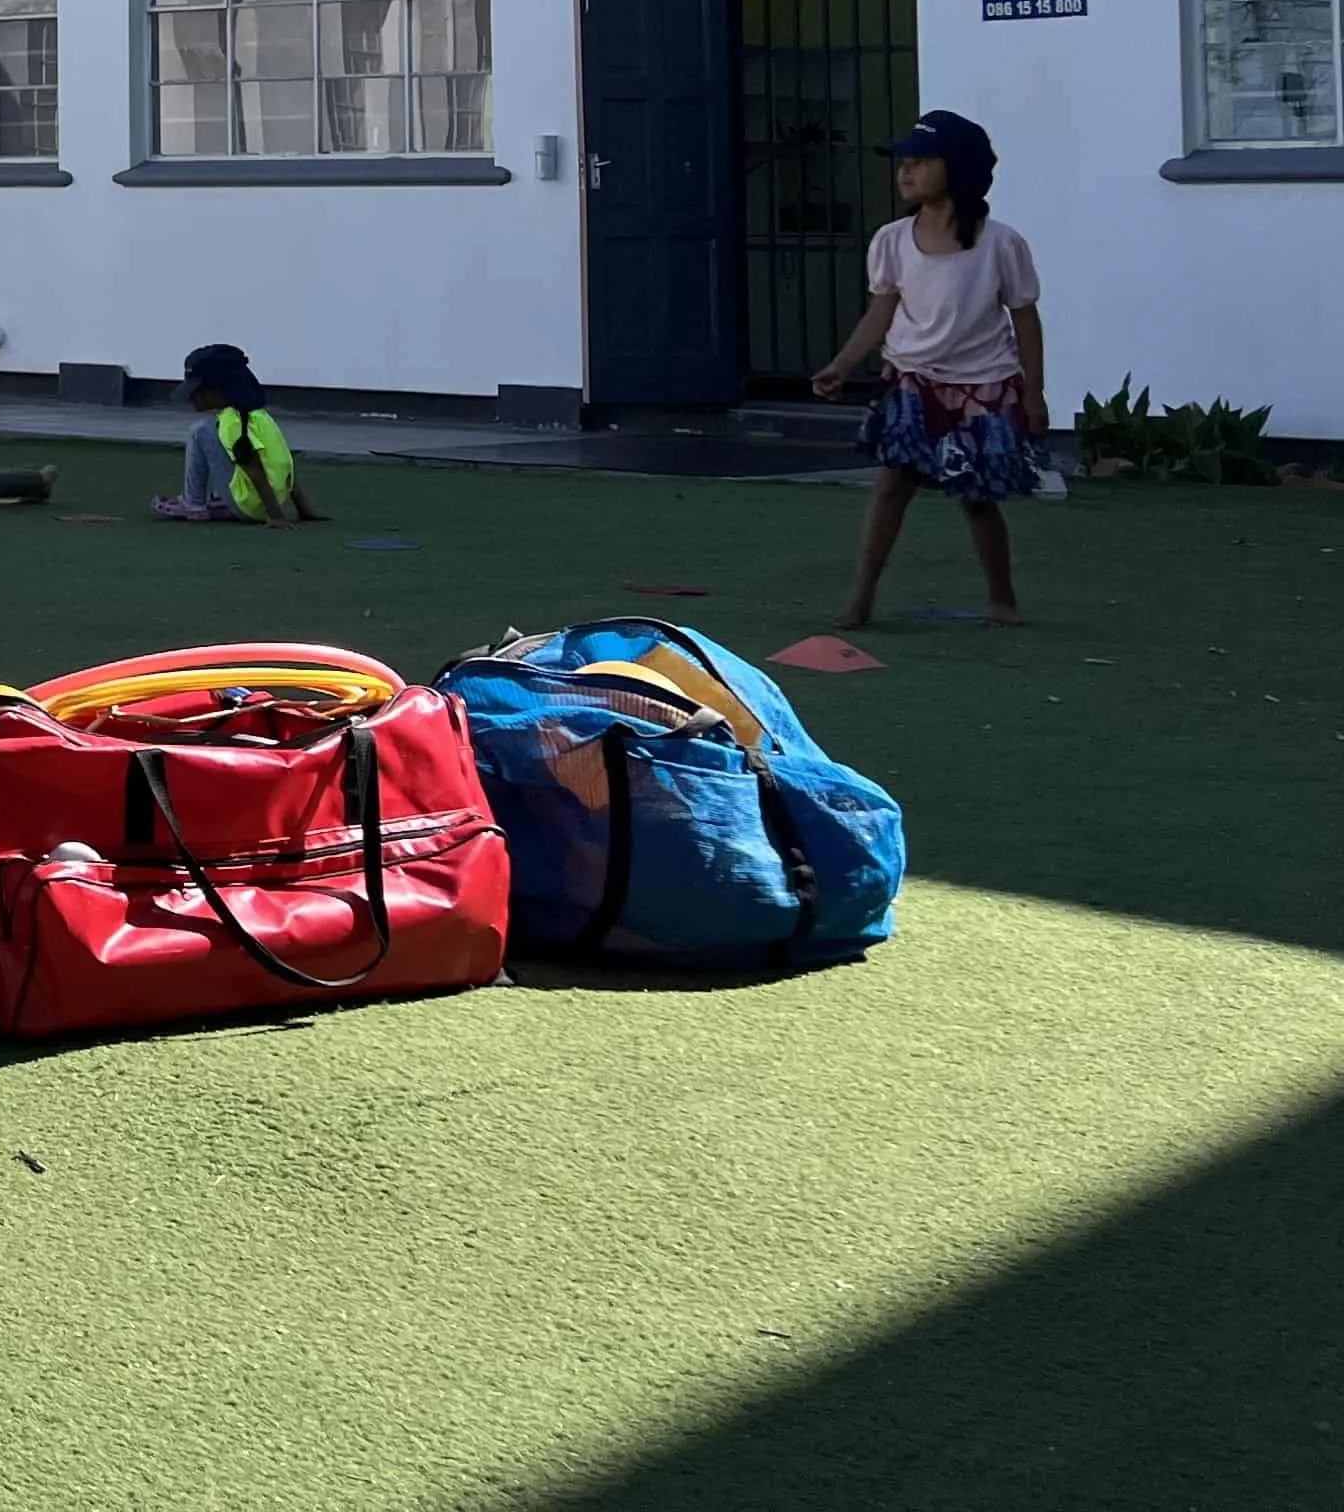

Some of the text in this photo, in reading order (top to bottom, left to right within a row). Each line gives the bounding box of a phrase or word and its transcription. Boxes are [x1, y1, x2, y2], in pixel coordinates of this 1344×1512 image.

[986, 2, 1012, 16] 086
[1016, 0, 1033, 15] 15
[1036, 0, 1051, 14] 15
